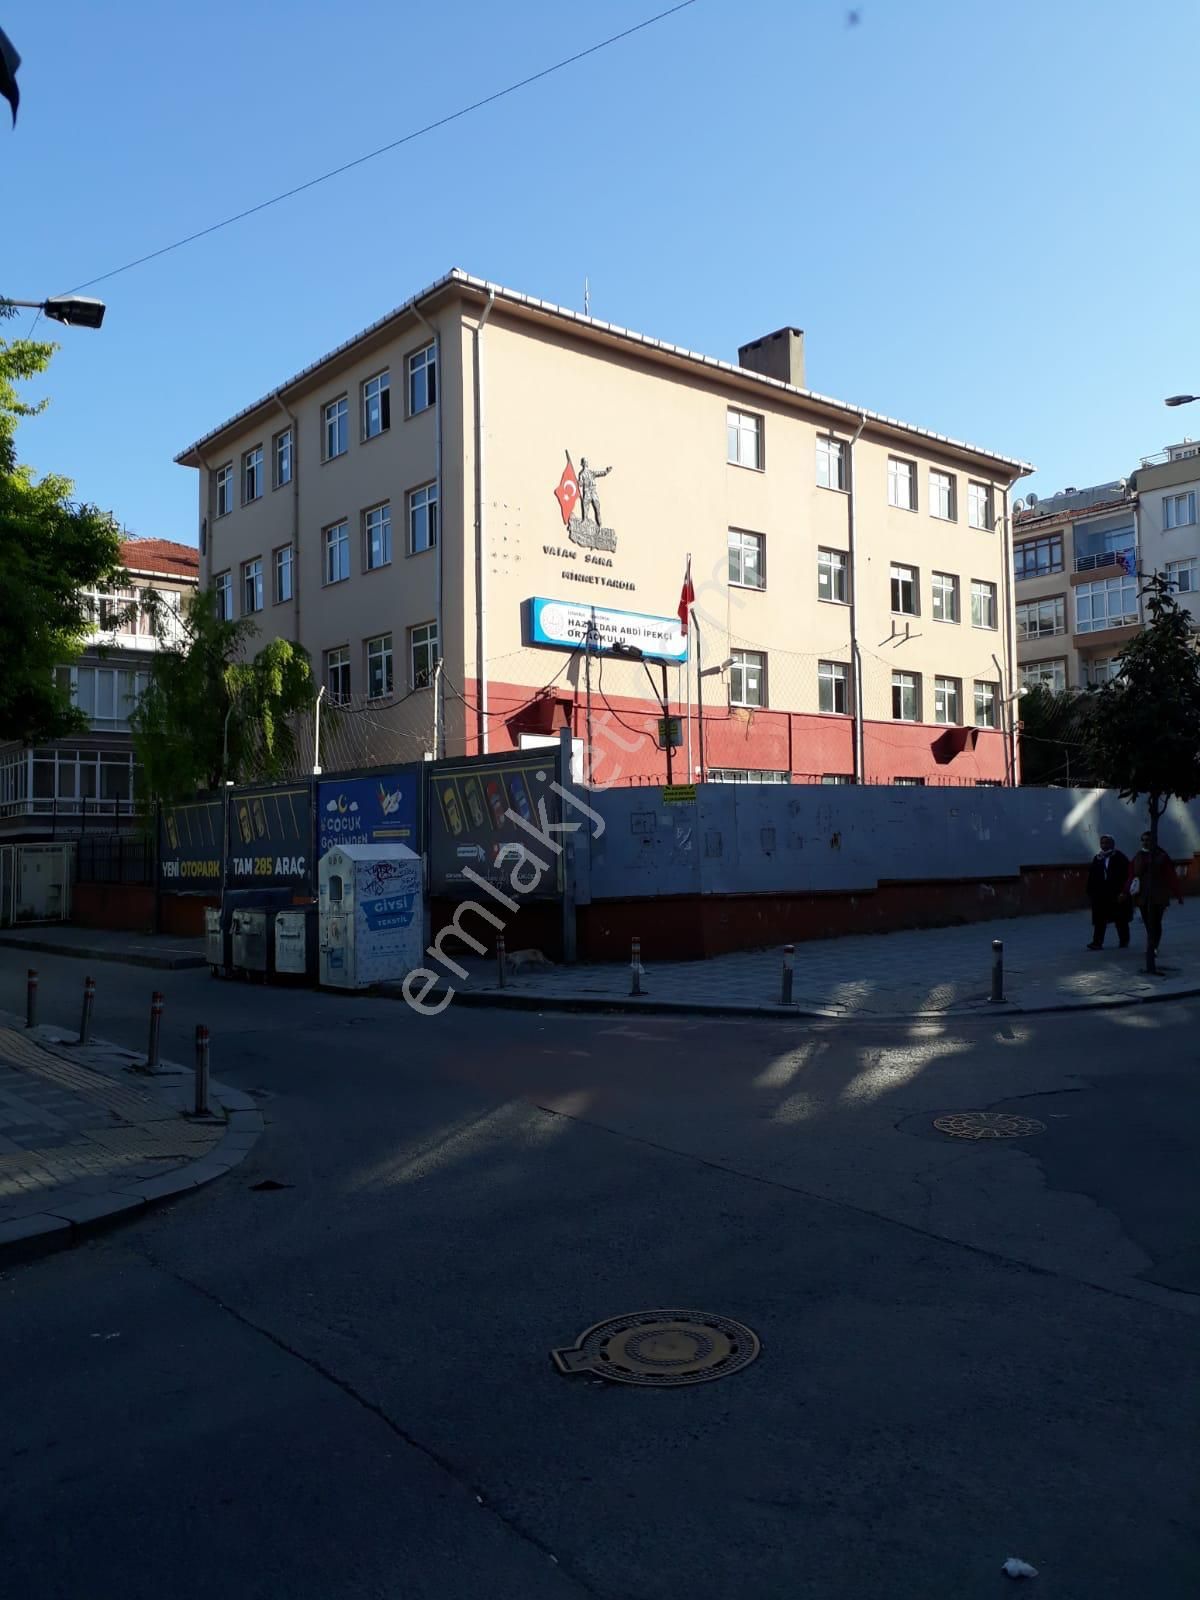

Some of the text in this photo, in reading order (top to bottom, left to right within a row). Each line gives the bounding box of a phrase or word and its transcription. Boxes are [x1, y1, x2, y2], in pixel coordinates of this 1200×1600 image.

[568, 618, 673, 641] HAZEDAR ABDİ İPEKÇİ
[161, 857, 220, 877] YENİ OTOPARK
[233, 856, 306, 879] TAM 285 ARAÇ
[374, 896, 408, 913] GİYSİ
